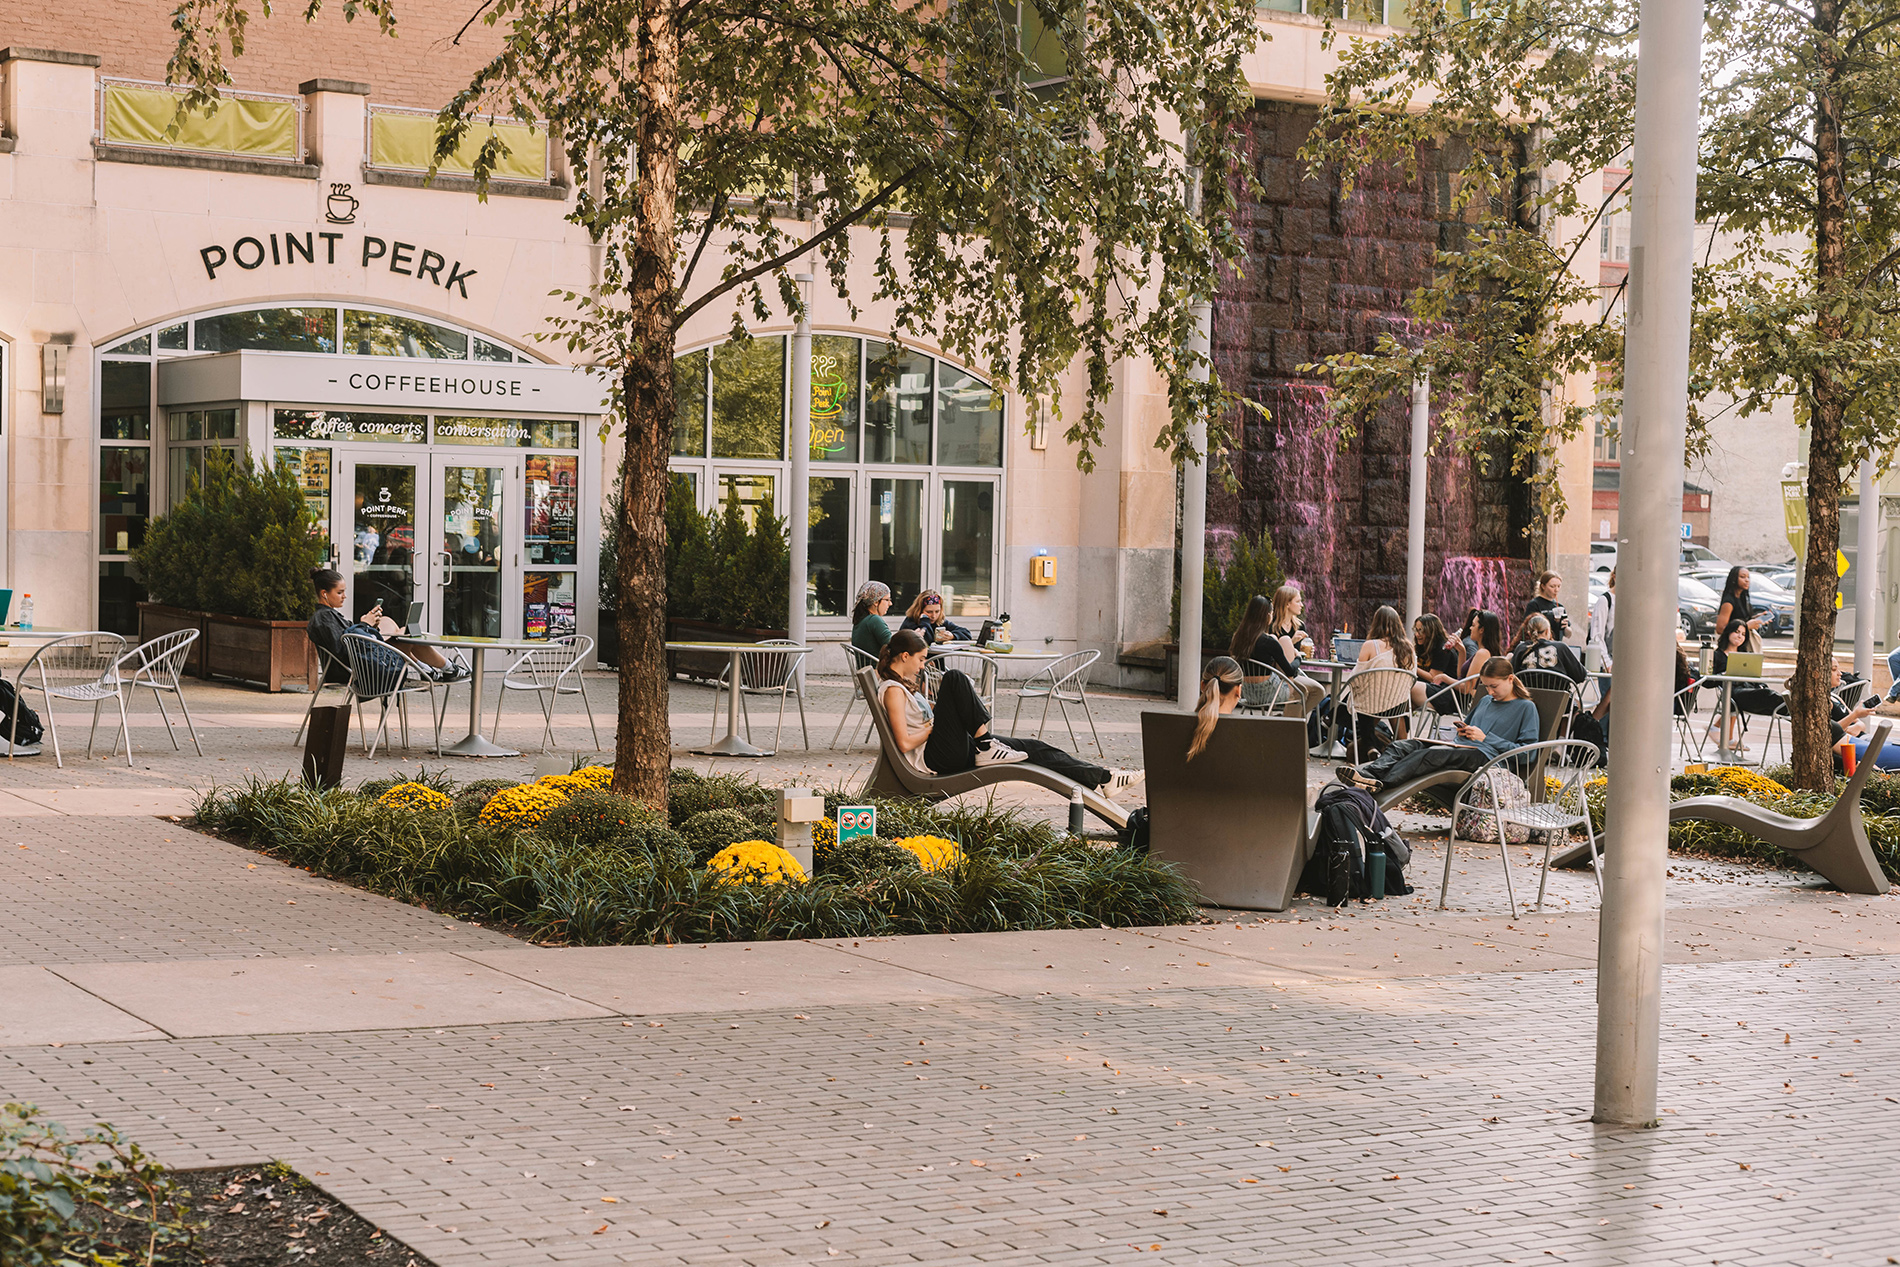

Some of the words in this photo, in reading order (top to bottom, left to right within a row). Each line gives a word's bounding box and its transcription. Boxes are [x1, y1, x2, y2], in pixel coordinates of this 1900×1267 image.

[200, 232, 343, 280] POINT
[362, 236, 477, 299] PERK
[349, 373, 521, 396] COFFEEHOUSE
[812, 386, 832, 397] Point
[812, 398, 830, 408] Perk
[437, 423, 532, 439] conversation.
[361, 505, 386, 515] POINT
[387, 505, 407, 517] PERK
[450, 507, 474, 516] POINT
[1522, 644, 1558, 669] 48
